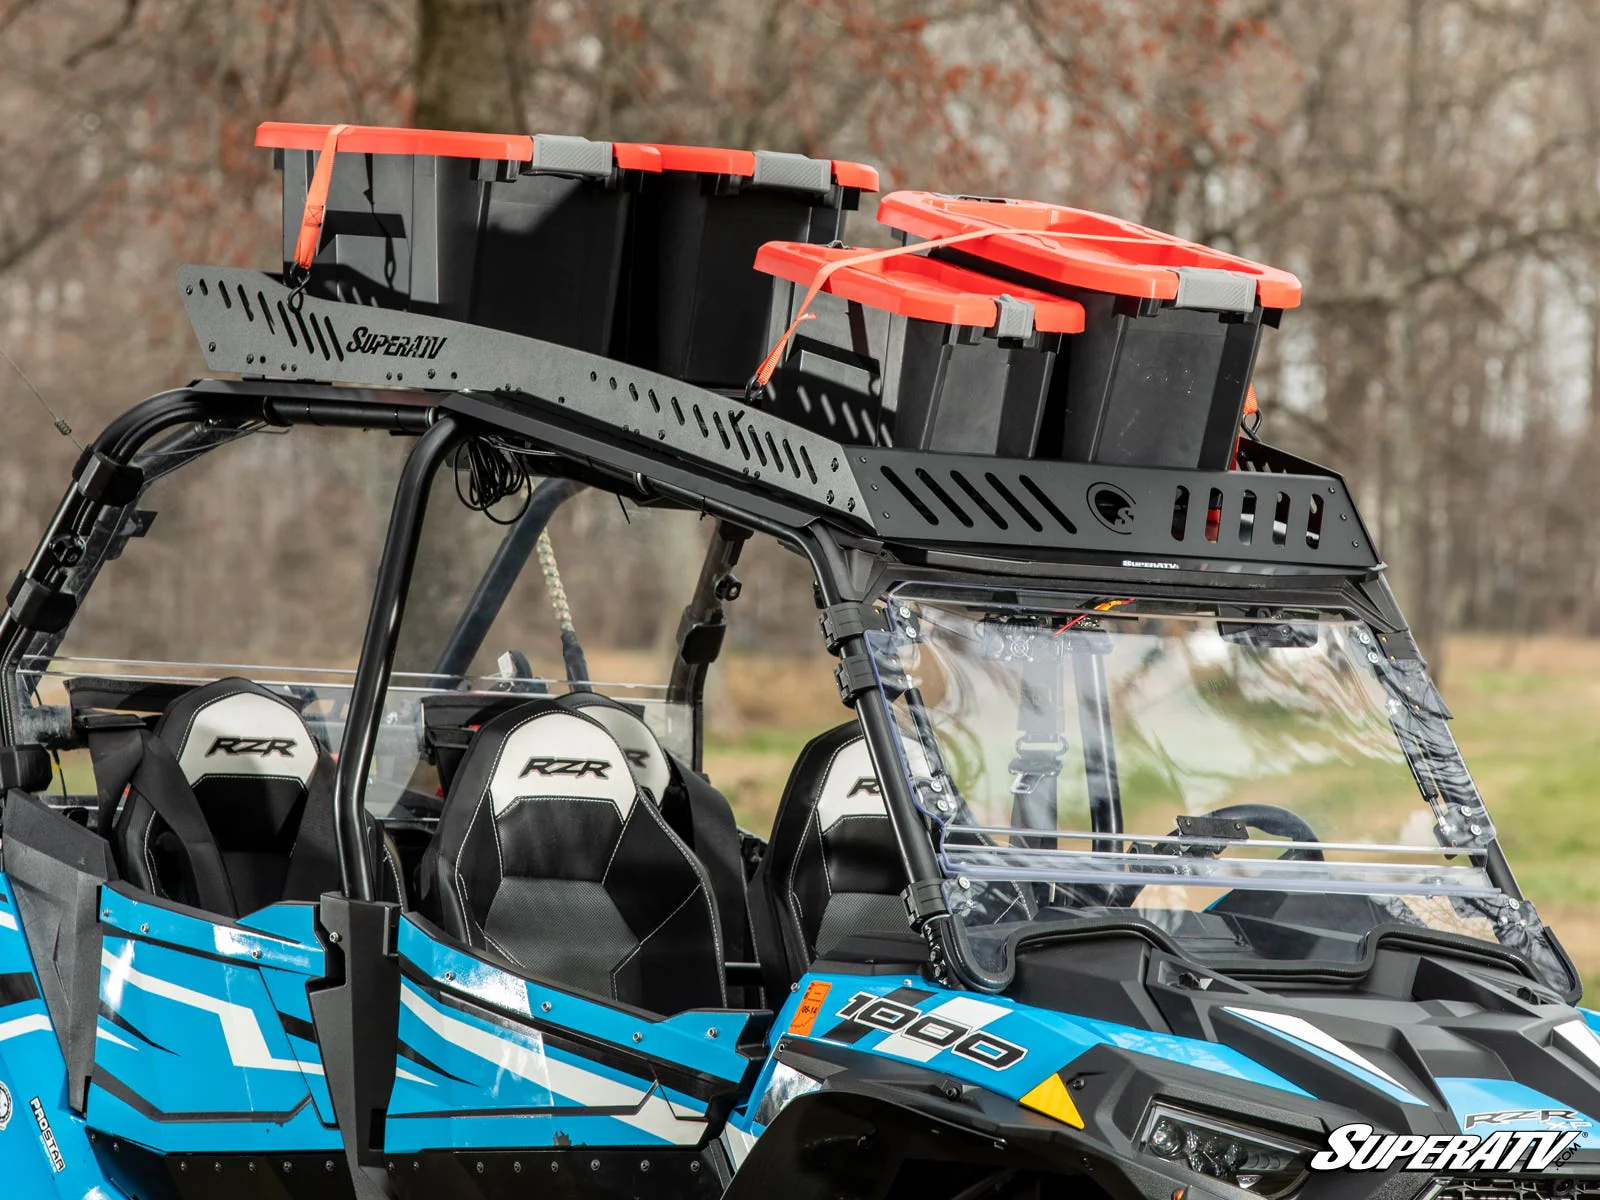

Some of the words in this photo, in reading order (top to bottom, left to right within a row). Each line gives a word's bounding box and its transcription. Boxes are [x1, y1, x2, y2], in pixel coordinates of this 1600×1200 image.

[347, 326, 448, 360] SUPERATV
[1122, 560, 1179, 570] SUPERATV
[205, 736, 298, 757] RZR
[518, 756, 613, 779] RZR
[835, 991, 1028, 1071] 1000
[1464, 1109, 1582, 1132] RZR
[30, 1097, 65, 1171] PROSTAR
